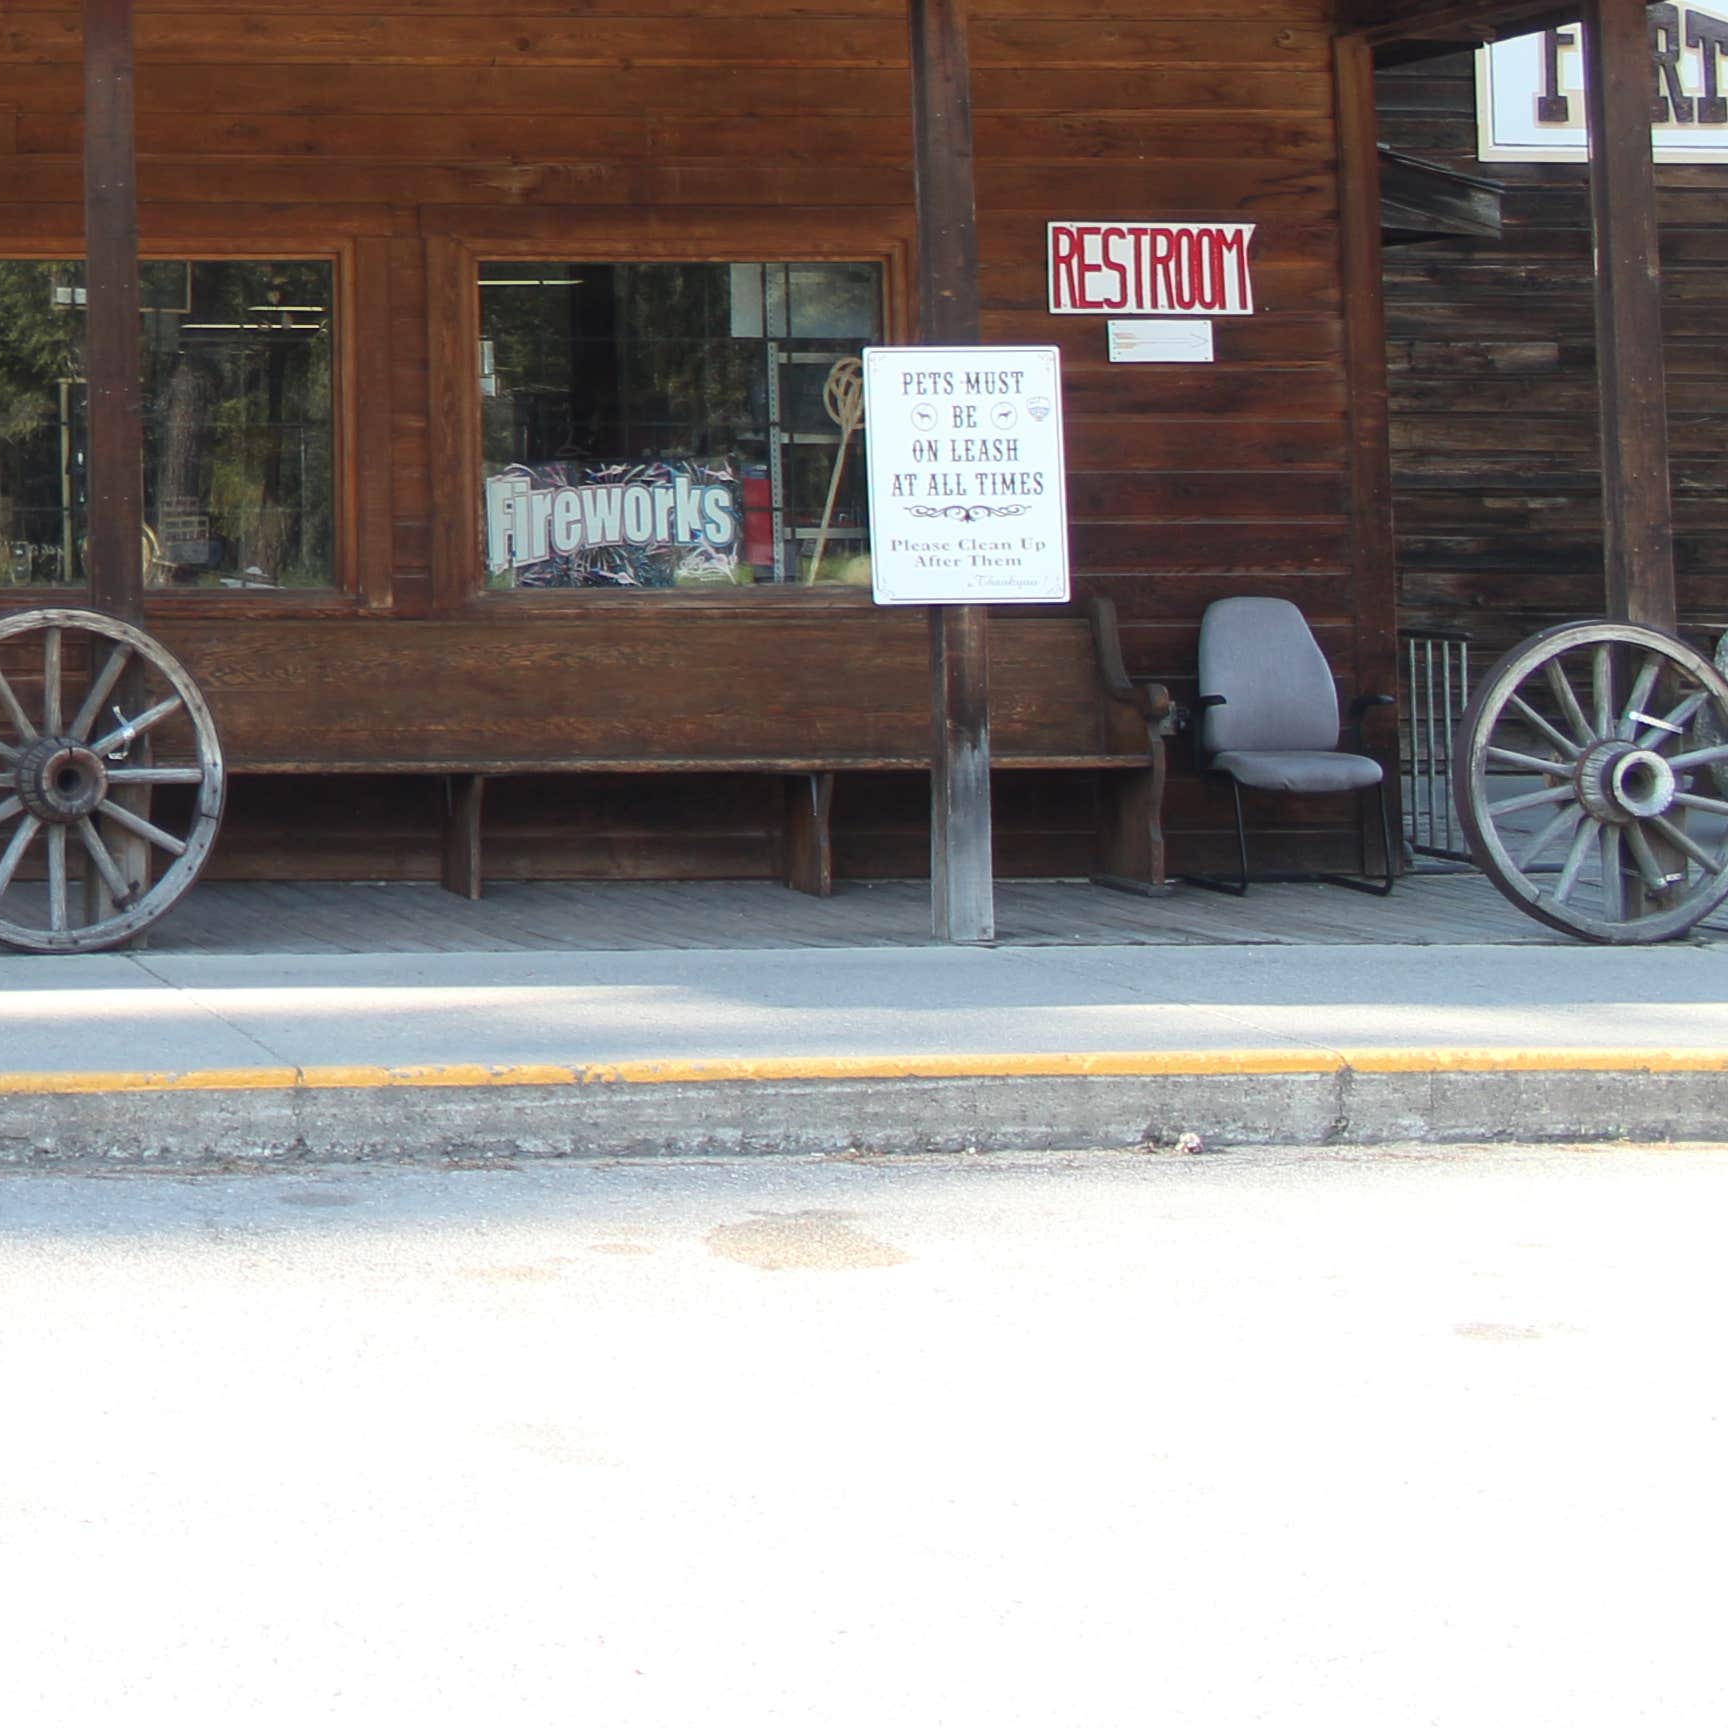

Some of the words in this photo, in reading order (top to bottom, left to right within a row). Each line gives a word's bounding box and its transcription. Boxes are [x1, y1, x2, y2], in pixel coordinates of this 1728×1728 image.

[1051, 225, 1249, 311] RESTROOM
[901, 371, 955, 396] PETS
[964, 370, 1025, 395] MUST
[951, 404, 978, 429] BE
[911, 438, 940, 463] ON
[950, 438, 1020, 463] LEASH
[891, 473, 918, 497] AT
[926, 472, 968, 497] ALL
[974, 471, 1045, 496] TIMES
[486, 473, 734, 574] Fireworks
[889, 538, 951, 553] Please
[957, 537, 1013, 552] Clean
[1020, 537, 1047, 554] Up
[914, 554, 962, 569] After
[966, 554, 1023, 568] Them
